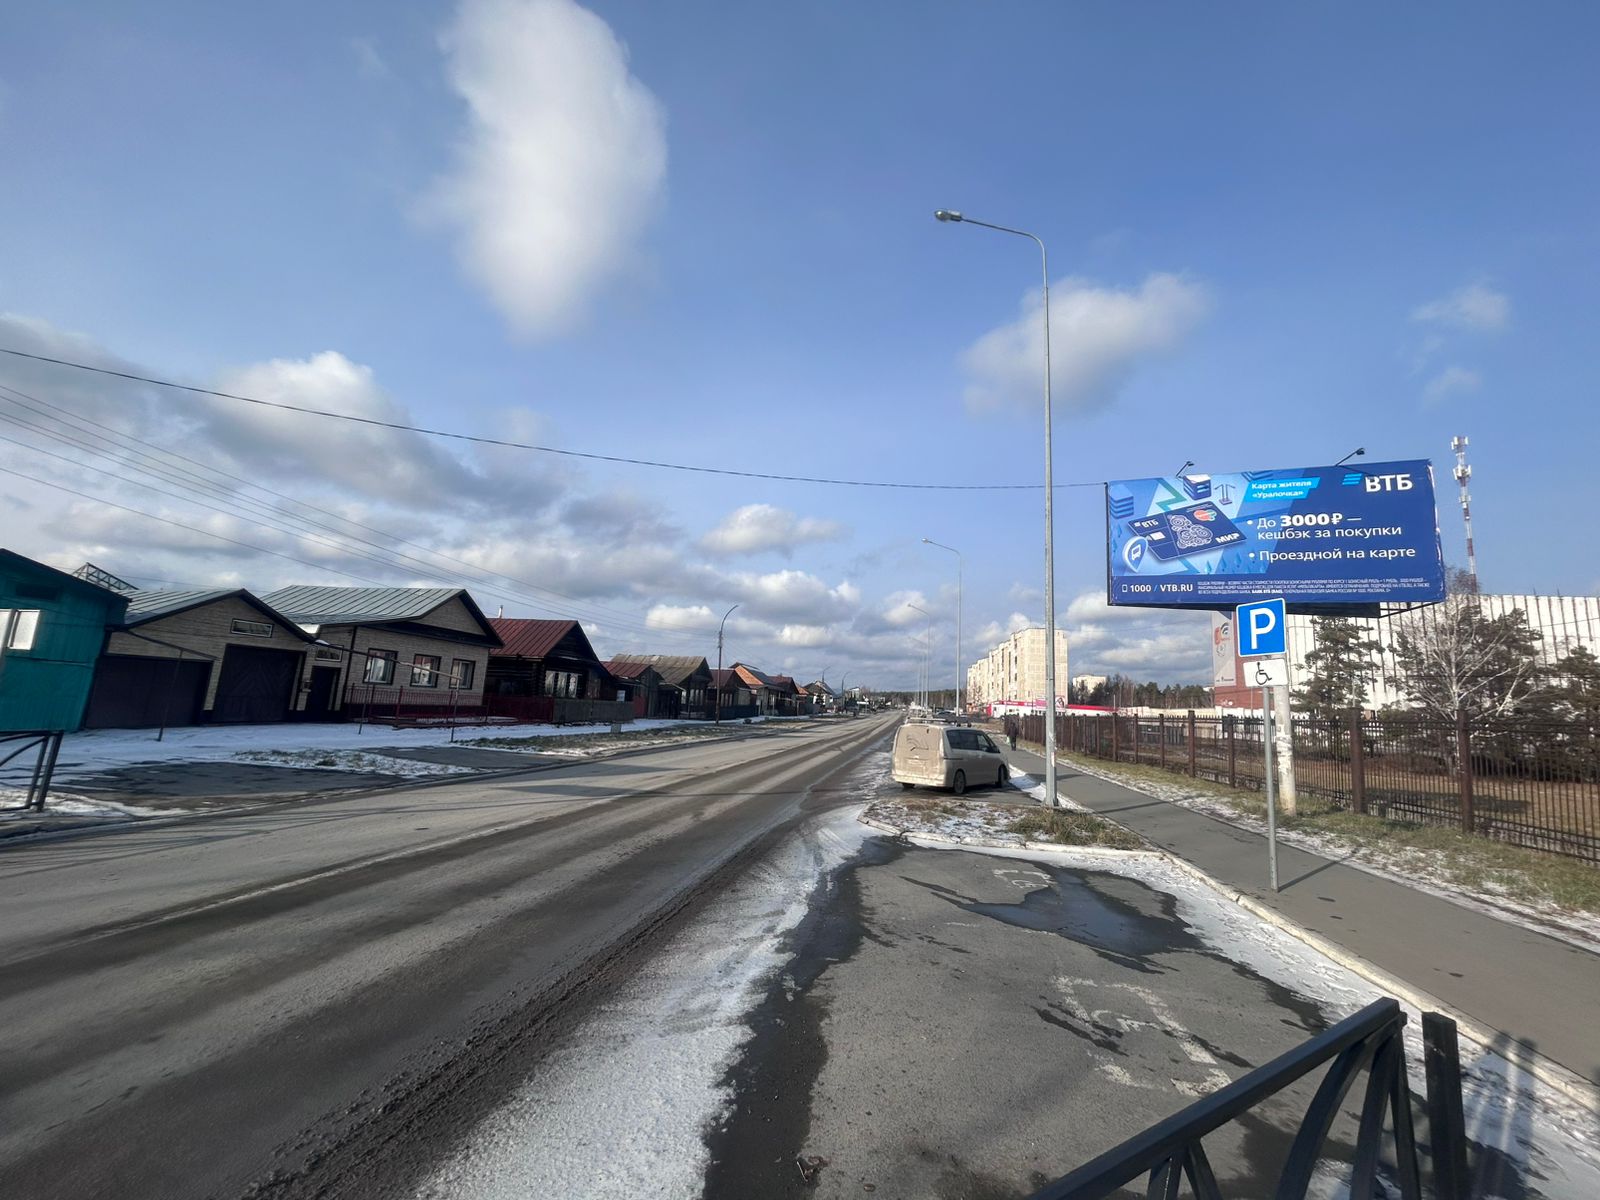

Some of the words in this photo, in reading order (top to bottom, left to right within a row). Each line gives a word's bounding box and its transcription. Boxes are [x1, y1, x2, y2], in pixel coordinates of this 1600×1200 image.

[1251, 482, 1277, 490] Карта
[1279, 480, 1312, 488] жителя
[1365, 474, 1413, 493] ВТБ
[1252, 490, 1304, 499] «Уралочка»
[1141, 519, 1159, 528] ВТБ
[1256, 518, 1277, 530] До
[1280, 512, 1343, 527] 3000₽
[1215, 532, 1240, 543] МИР
[1257, 528, 1311, 540] кешбэк
[1314, 530, 1331, 538] за
[1335, 526, 1402, 539] покупки
[1259, 548, 1342, 563] Проездной
[1346, 549, 1365, 559] на
[1369, 547, 1416, 560] карте
[1130, 584, 1152, 592] 1000
[1160, 584, 1193, 592] VTB.RU
